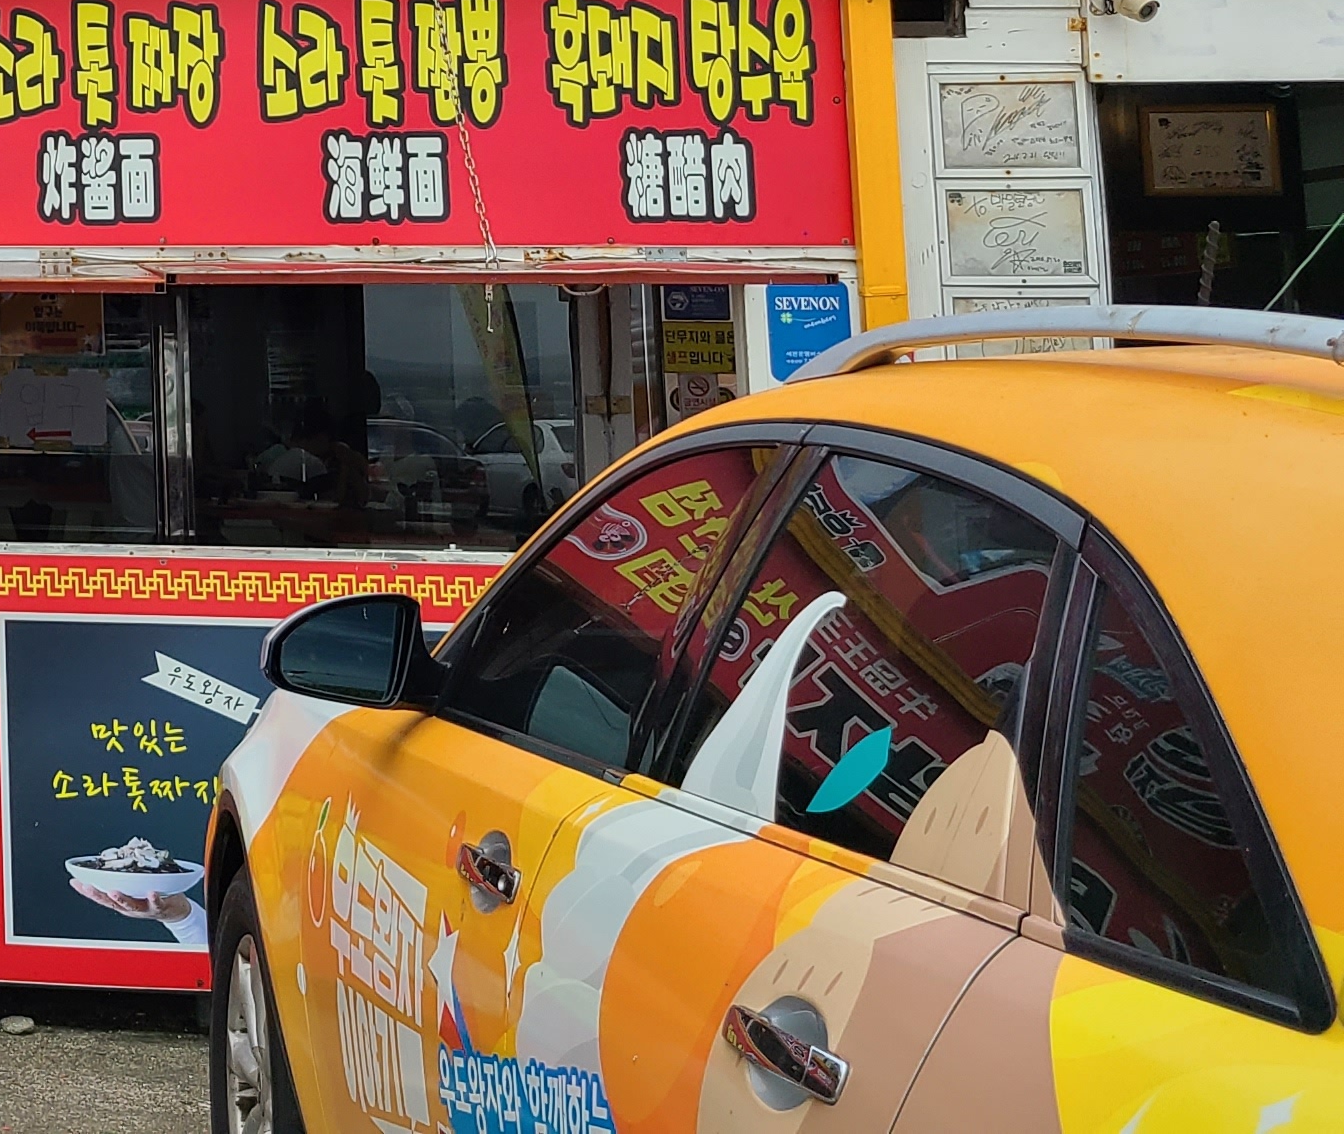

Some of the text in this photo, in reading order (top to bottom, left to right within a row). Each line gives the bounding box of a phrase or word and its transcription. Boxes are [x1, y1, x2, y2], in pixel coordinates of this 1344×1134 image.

[76, 4, 114, 126] 톳
[127, 4, 222, 125] 짜장
[264, 4, 344, 120] 소라
[326, 133, 447, 220] 海鲜面
[624, 133, 751, 220] 糖醋肉
[665, 330, 734, 344] 단무지와 물은
[775, 296, 840, 311] SEVENON
[666, 351, 724, 365] 셀프입니다
[19, 383, 83, 426] 입구
[167, 666, 245, 711] 우도왕자
[91, 719, 188, 757] 맛있는
[330, 823, 425, 1028] 우도왕자
[336, 977, 405, 1117] 이야기
[439, 1049, 522, 1134] 우도왕자와
